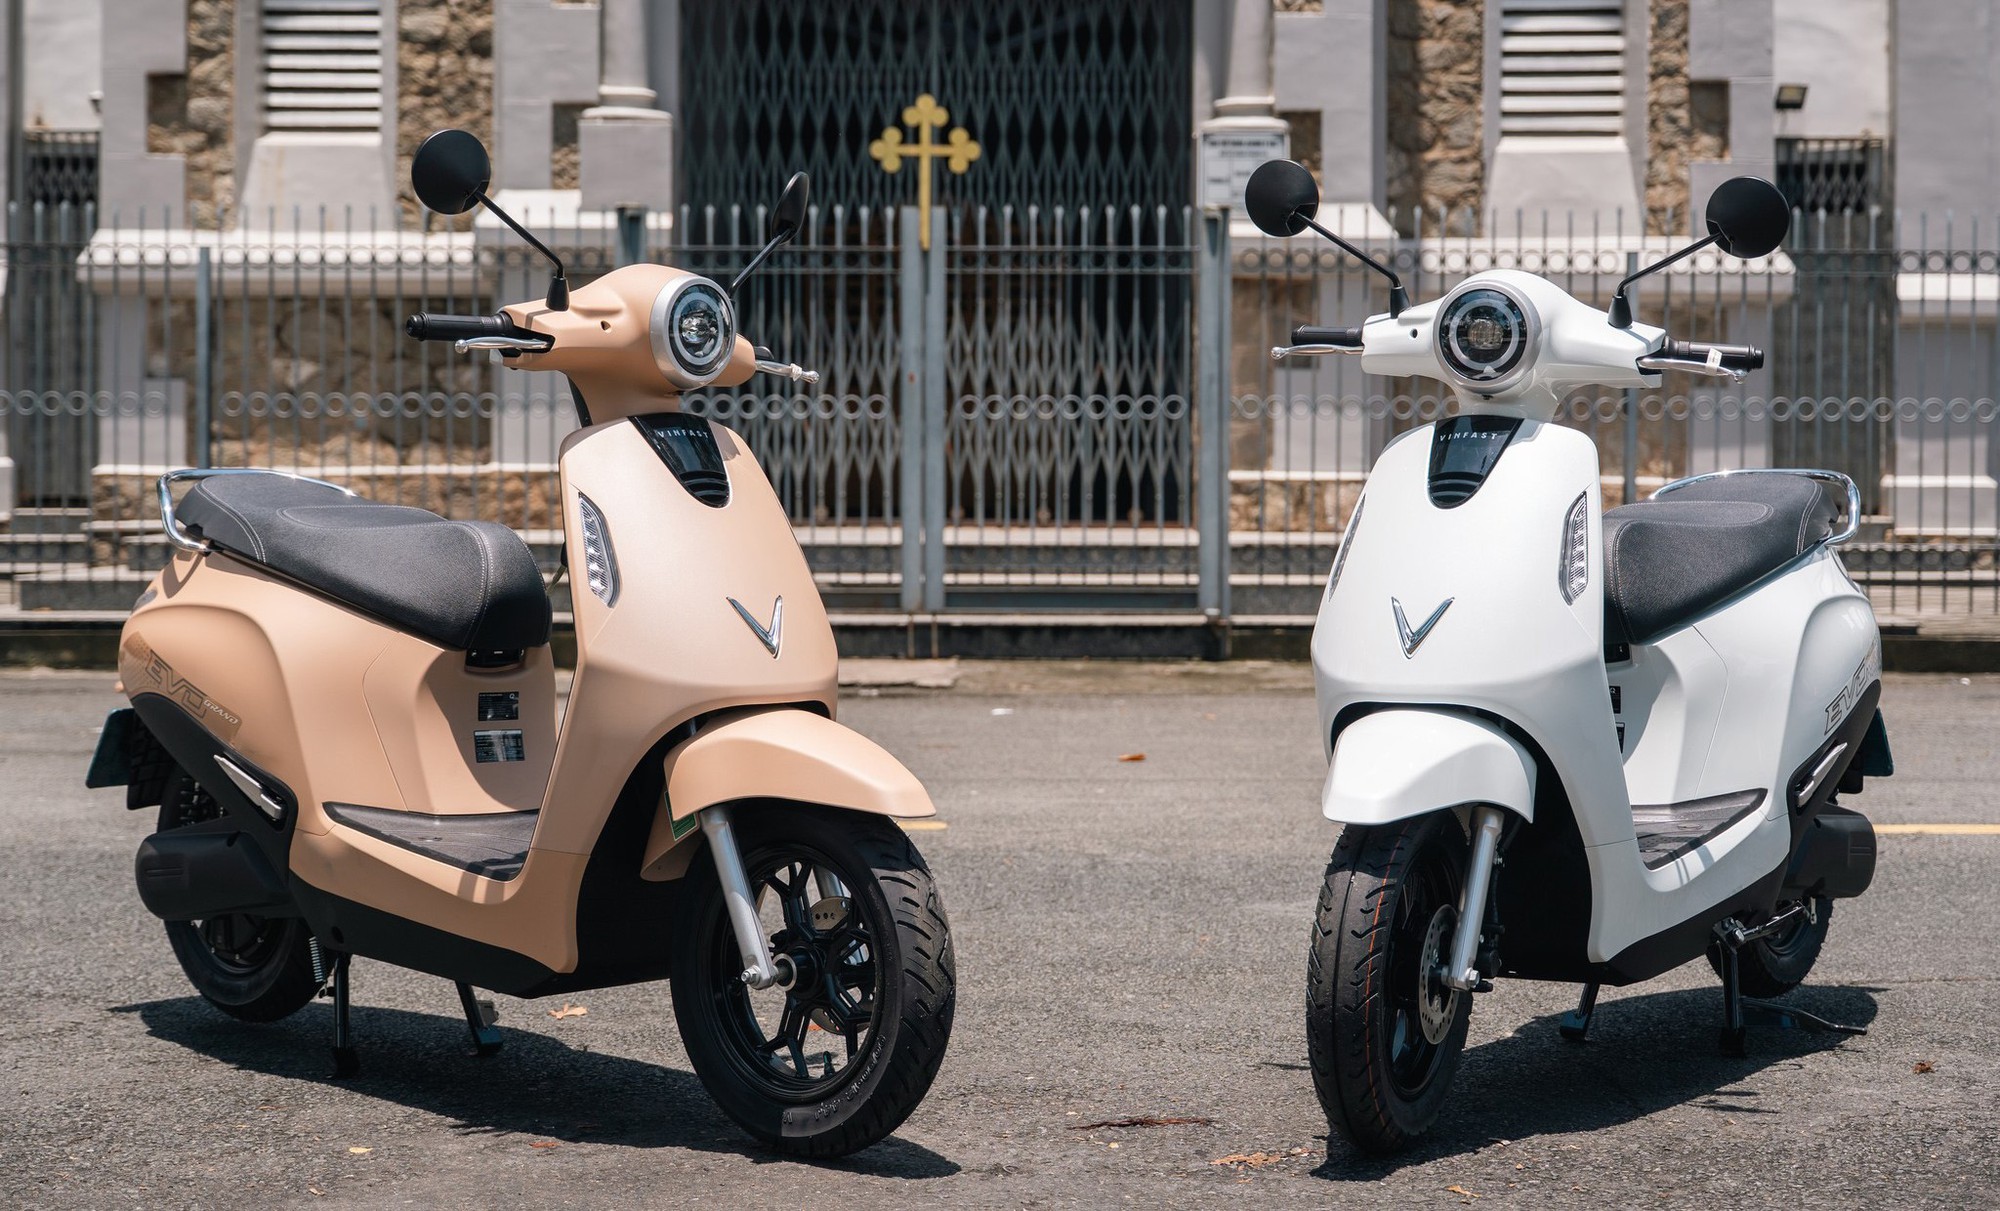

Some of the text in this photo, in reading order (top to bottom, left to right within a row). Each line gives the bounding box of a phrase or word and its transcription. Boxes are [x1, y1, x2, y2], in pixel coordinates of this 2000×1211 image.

[657, 429, 708, 439] VINFAST
[1439, 432, 1498, 442] VINFAST
[145, 649, 239, 725] EVO GRAND
